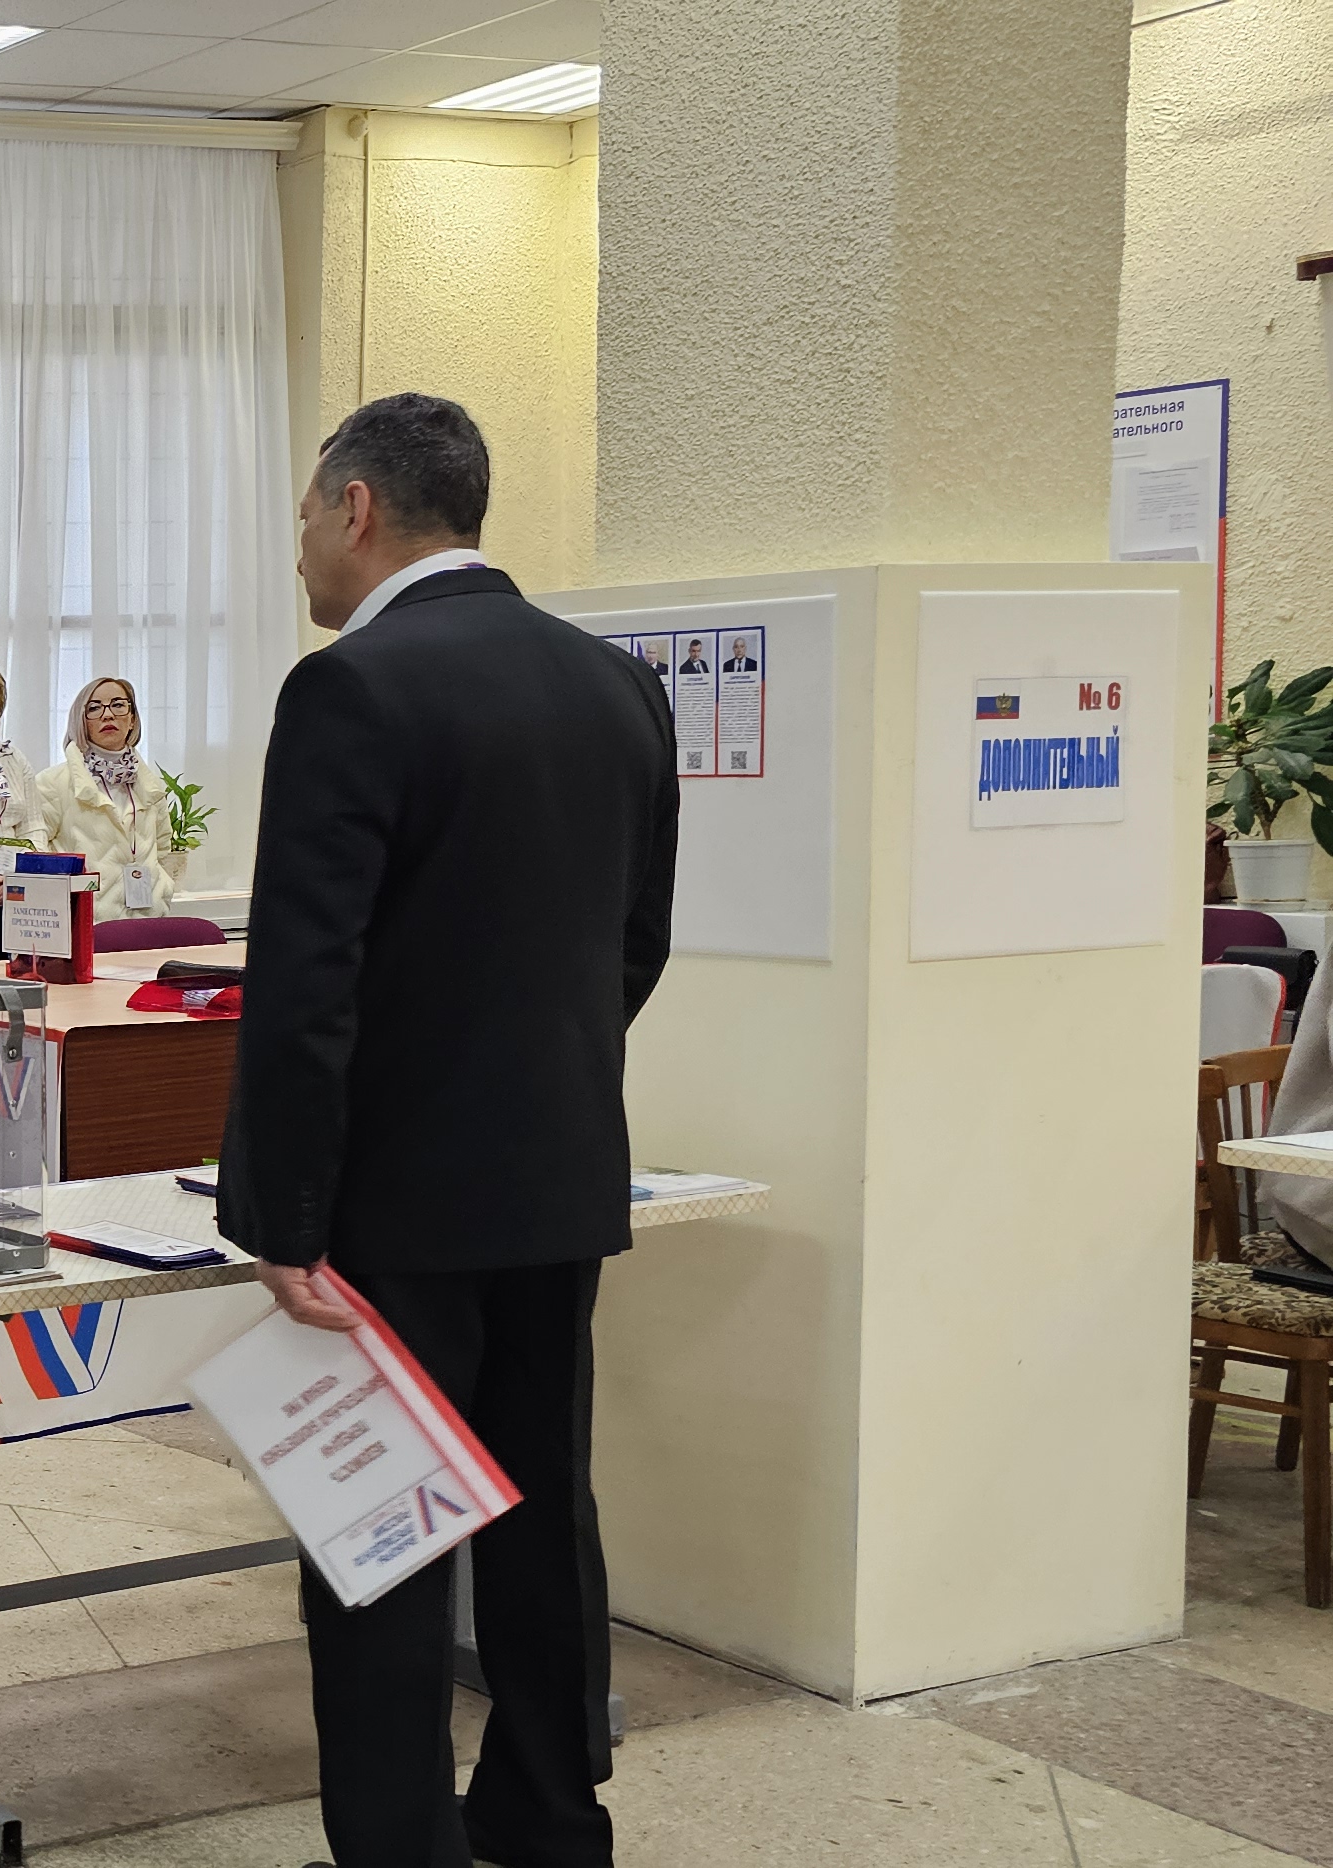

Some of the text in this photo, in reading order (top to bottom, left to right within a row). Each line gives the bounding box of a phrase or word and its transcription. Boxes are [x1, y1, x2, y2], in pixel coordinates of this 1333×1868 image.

[1079, 682, 1121, 711] № 6
[979, 725, 1119, 801] ДОПОЛНИТЕЛЬНЫЙ
[13, 907, 58, 917] ЗАМЕСТИТЕЛЬ
[12, 918, 60, 928] ПРЕДСЕДАТЕЛЯ
